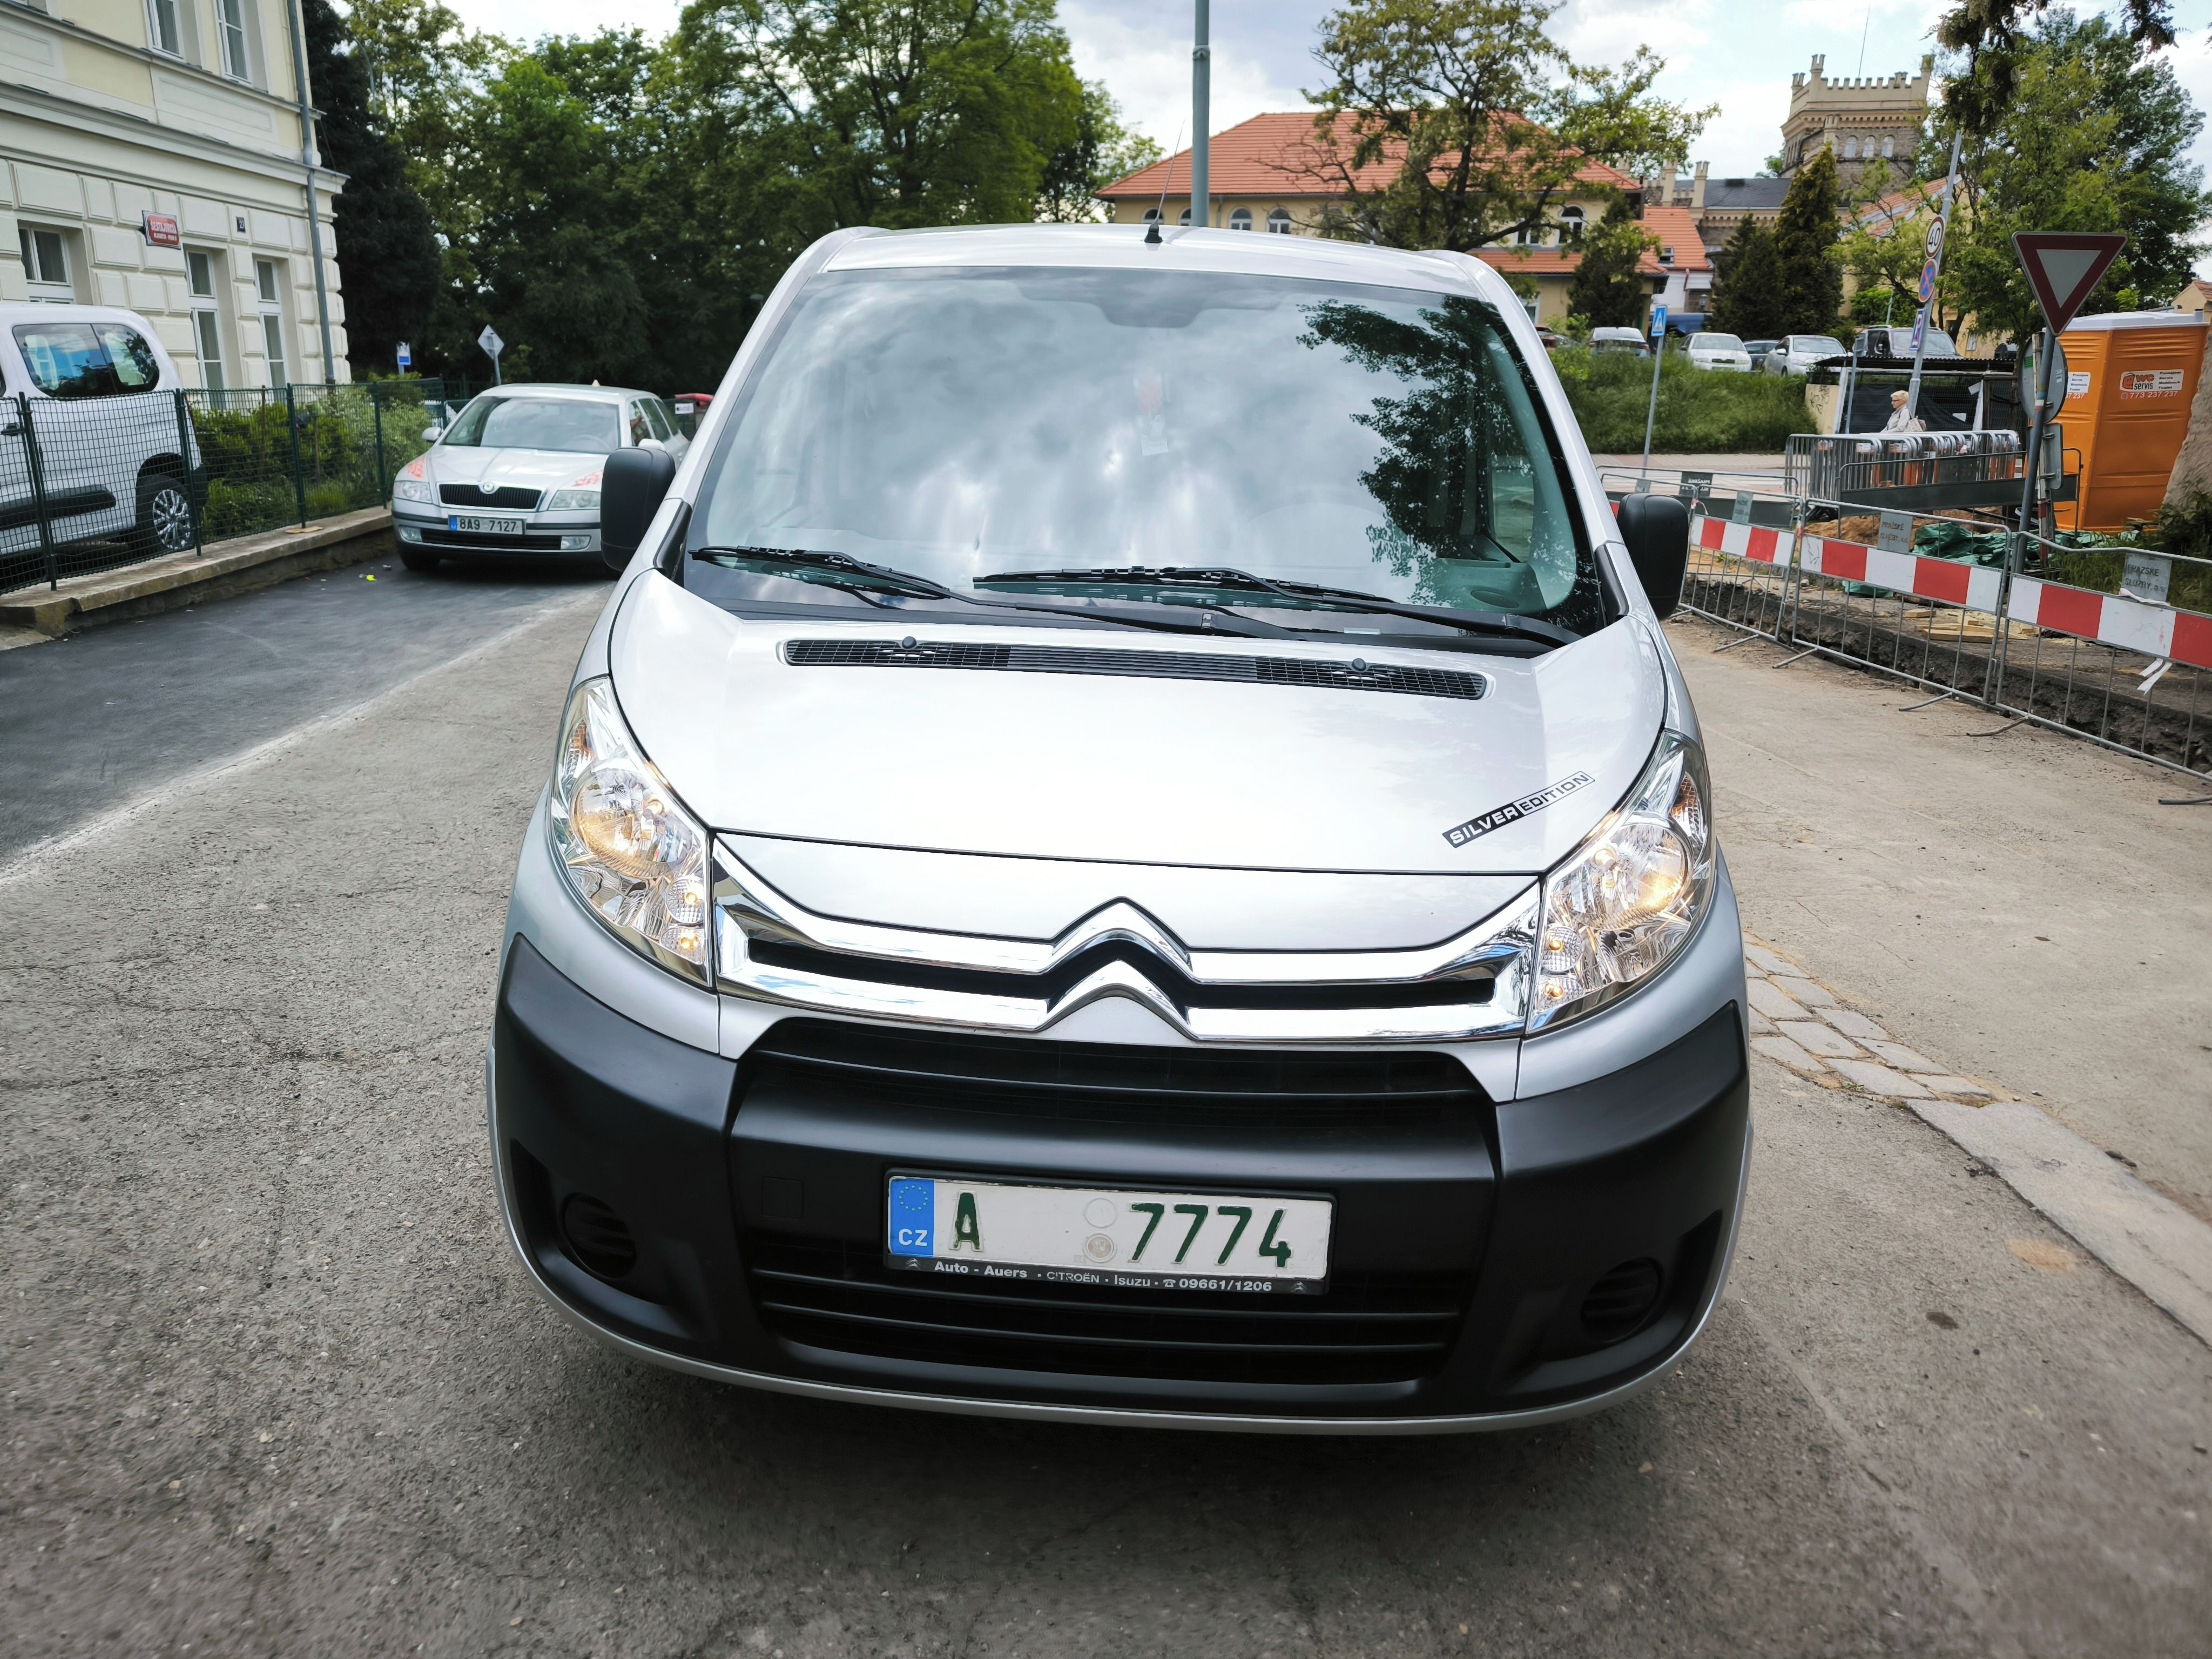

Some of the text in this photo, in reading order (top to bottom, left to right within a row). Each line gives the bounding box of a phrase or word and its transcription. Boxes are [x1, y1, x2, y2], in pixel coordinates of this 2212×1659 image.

[1928, 227, 1941, 247] 40
[2134, 381, 2153, 390] servis
[460, 518, 480, 530] 8A9
[489, 520, 517, 532] 7127
[1449, 774, 1589, 844] SILVER EDITION
[899, 1228, 928, 1246] CZ
[954, 1191, 1292, 1267] A 7774
[934, 1260, 1272, 1291] Auto Auers CITROËN Isuzu 09661/1206
